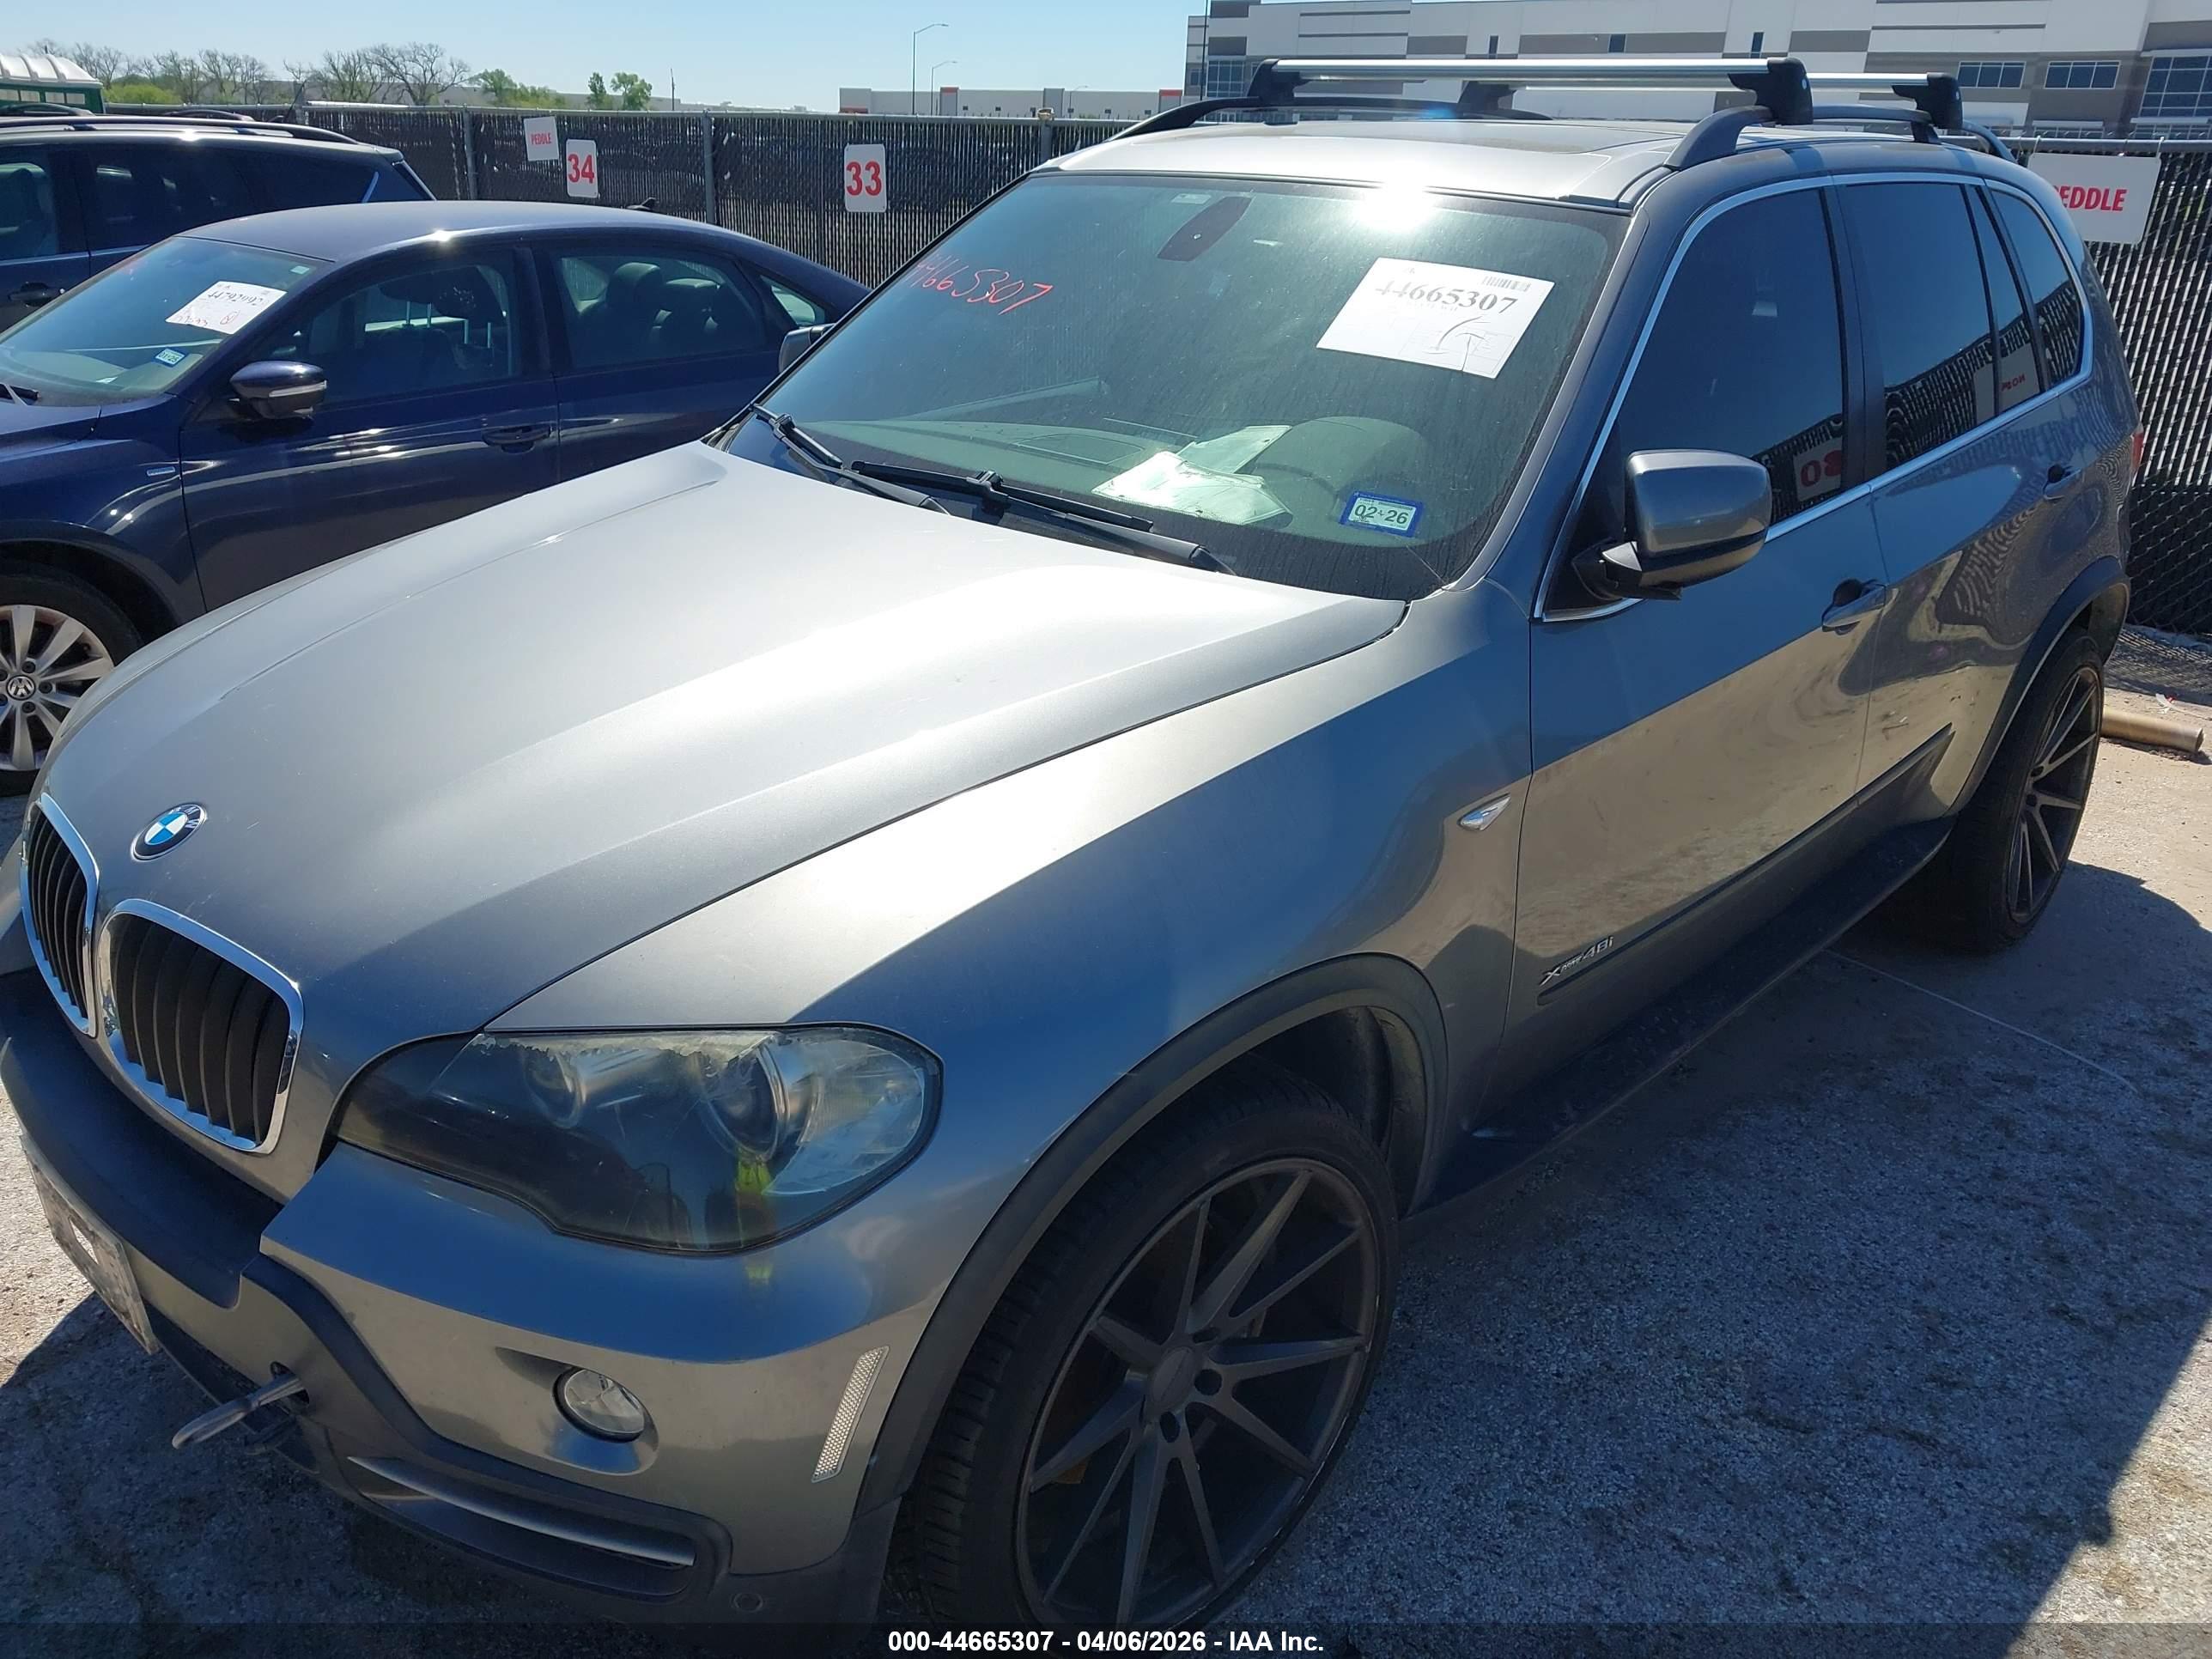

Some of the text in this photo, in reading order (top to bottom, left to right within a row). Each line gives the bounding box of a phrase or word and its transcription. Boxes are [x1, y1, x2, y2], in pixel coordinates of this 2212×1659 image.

[568, 154, 594, 184] 34
[847, 161, 882, 196] 33
[1375, 280, 1519, 314] 44665307
